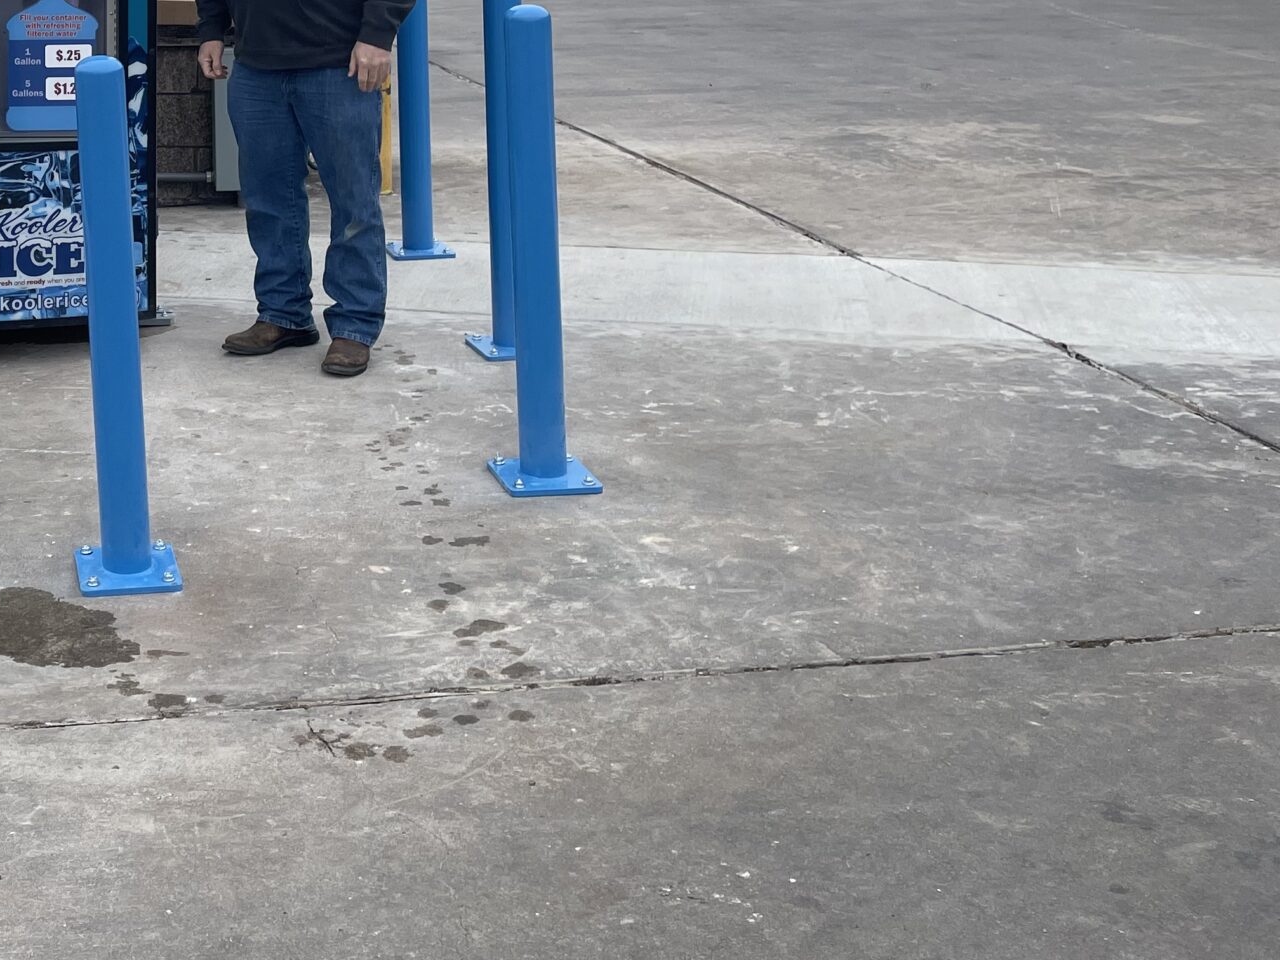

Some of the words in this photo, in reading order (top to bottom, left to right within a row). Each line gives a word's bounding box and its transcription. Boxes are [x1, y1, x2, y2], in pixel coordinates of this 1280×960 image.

[24, 48, 31, 56] 1
[56, 49, 81, 63] $.25
[14, 58, 42, 66] Gallon
[25, 80, 31, 88] 5
[12, 89, 44, 98] Gallons
[26, 279, 46, 287] ready
